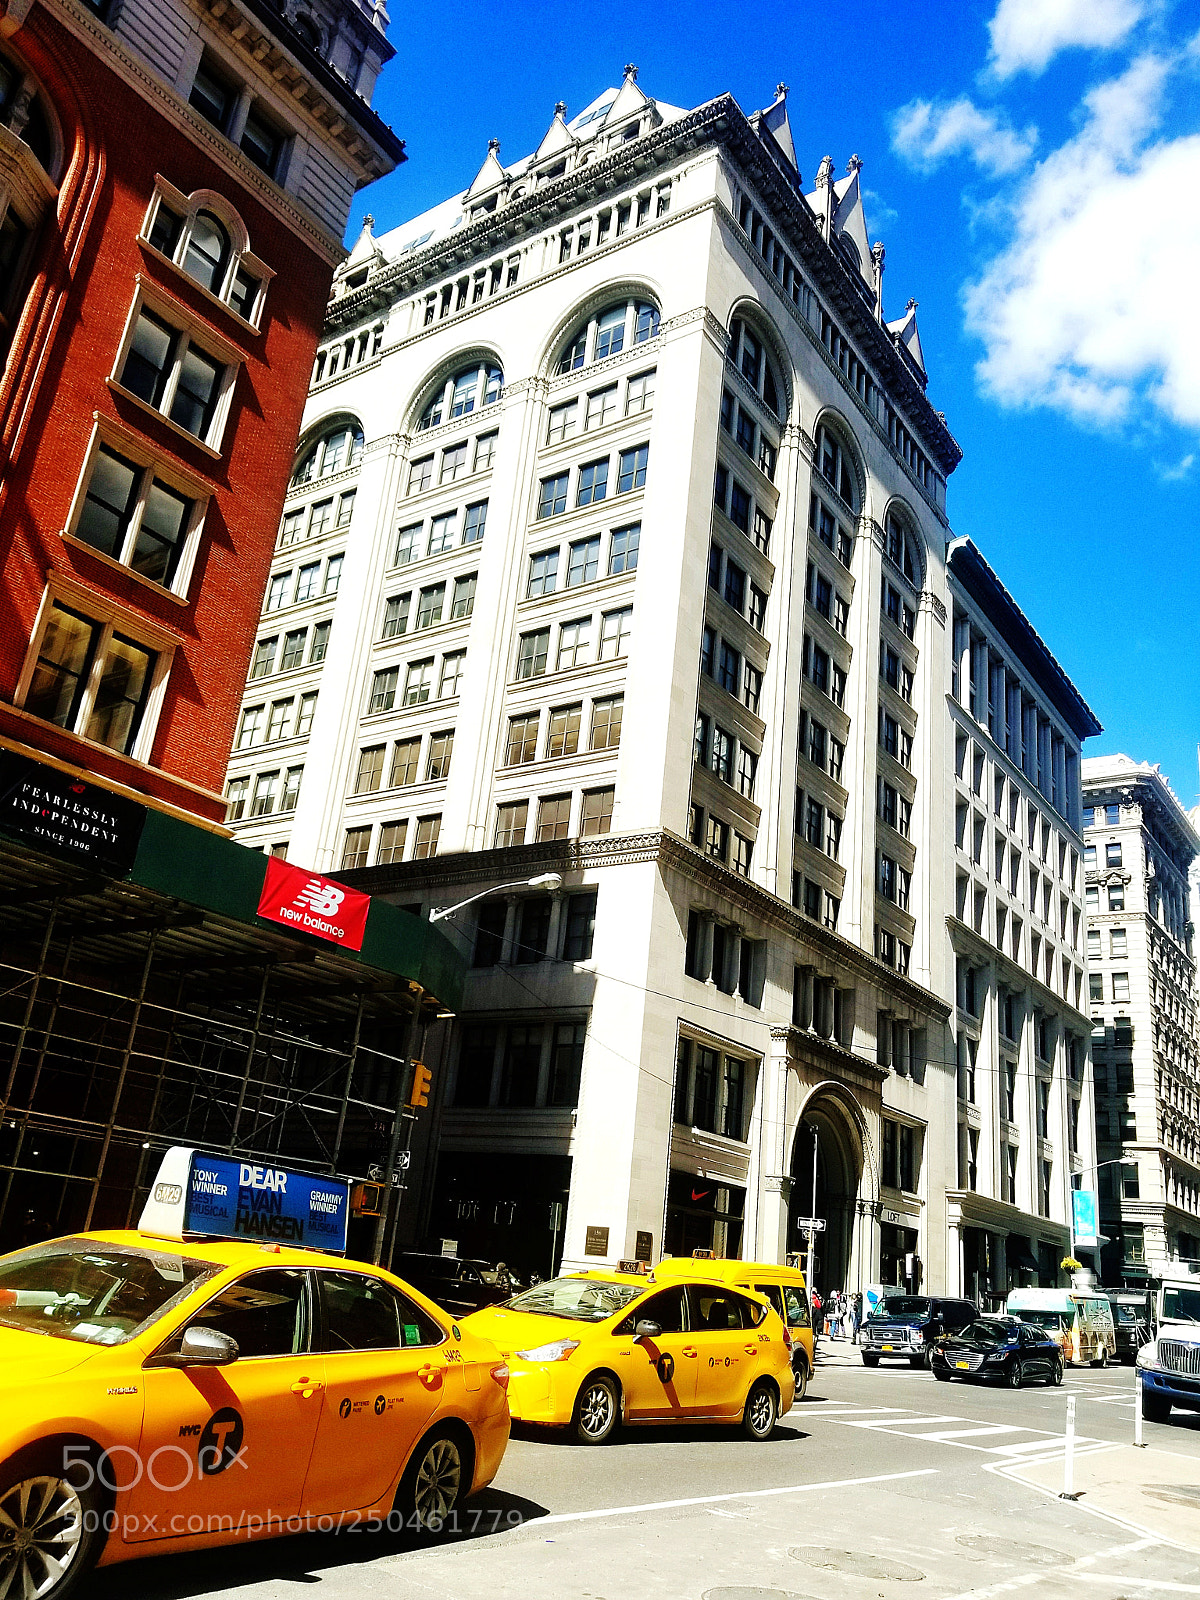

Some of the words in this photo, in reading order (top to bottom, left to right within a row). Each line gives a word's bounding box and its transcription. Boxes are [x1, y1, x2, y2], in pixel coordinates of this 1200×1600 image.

[22, 784, 118, 827] FEARLESSLY
[34, 826, 65, 842] SINCE
[69, 838, 90, 851] 1906
[279, 906, 303, 923] new
[303, 912, 345, 938] balance
[193, 1169, 219, 1183] TONY
[239, 1163, 287, 1194] DEAR
[192, 1180, 228, 1196] WINNER
[191, 1193, 215, 1205] BEST
[236, 1186, 283, 1215] EVAN
[310, 1190, 343, 1205] GRAMMY
[189, 1202, 229, 1218] MUSICAL
[309, 1200, 338, 1214] WINNER
[234, 1209, 304, 1241] HANSEN
[887, 1211, 900, 1223] LOFT
[308, 1220, 339, 1234] MUSICAL
[178, 1423, 202, 1437] NYC
